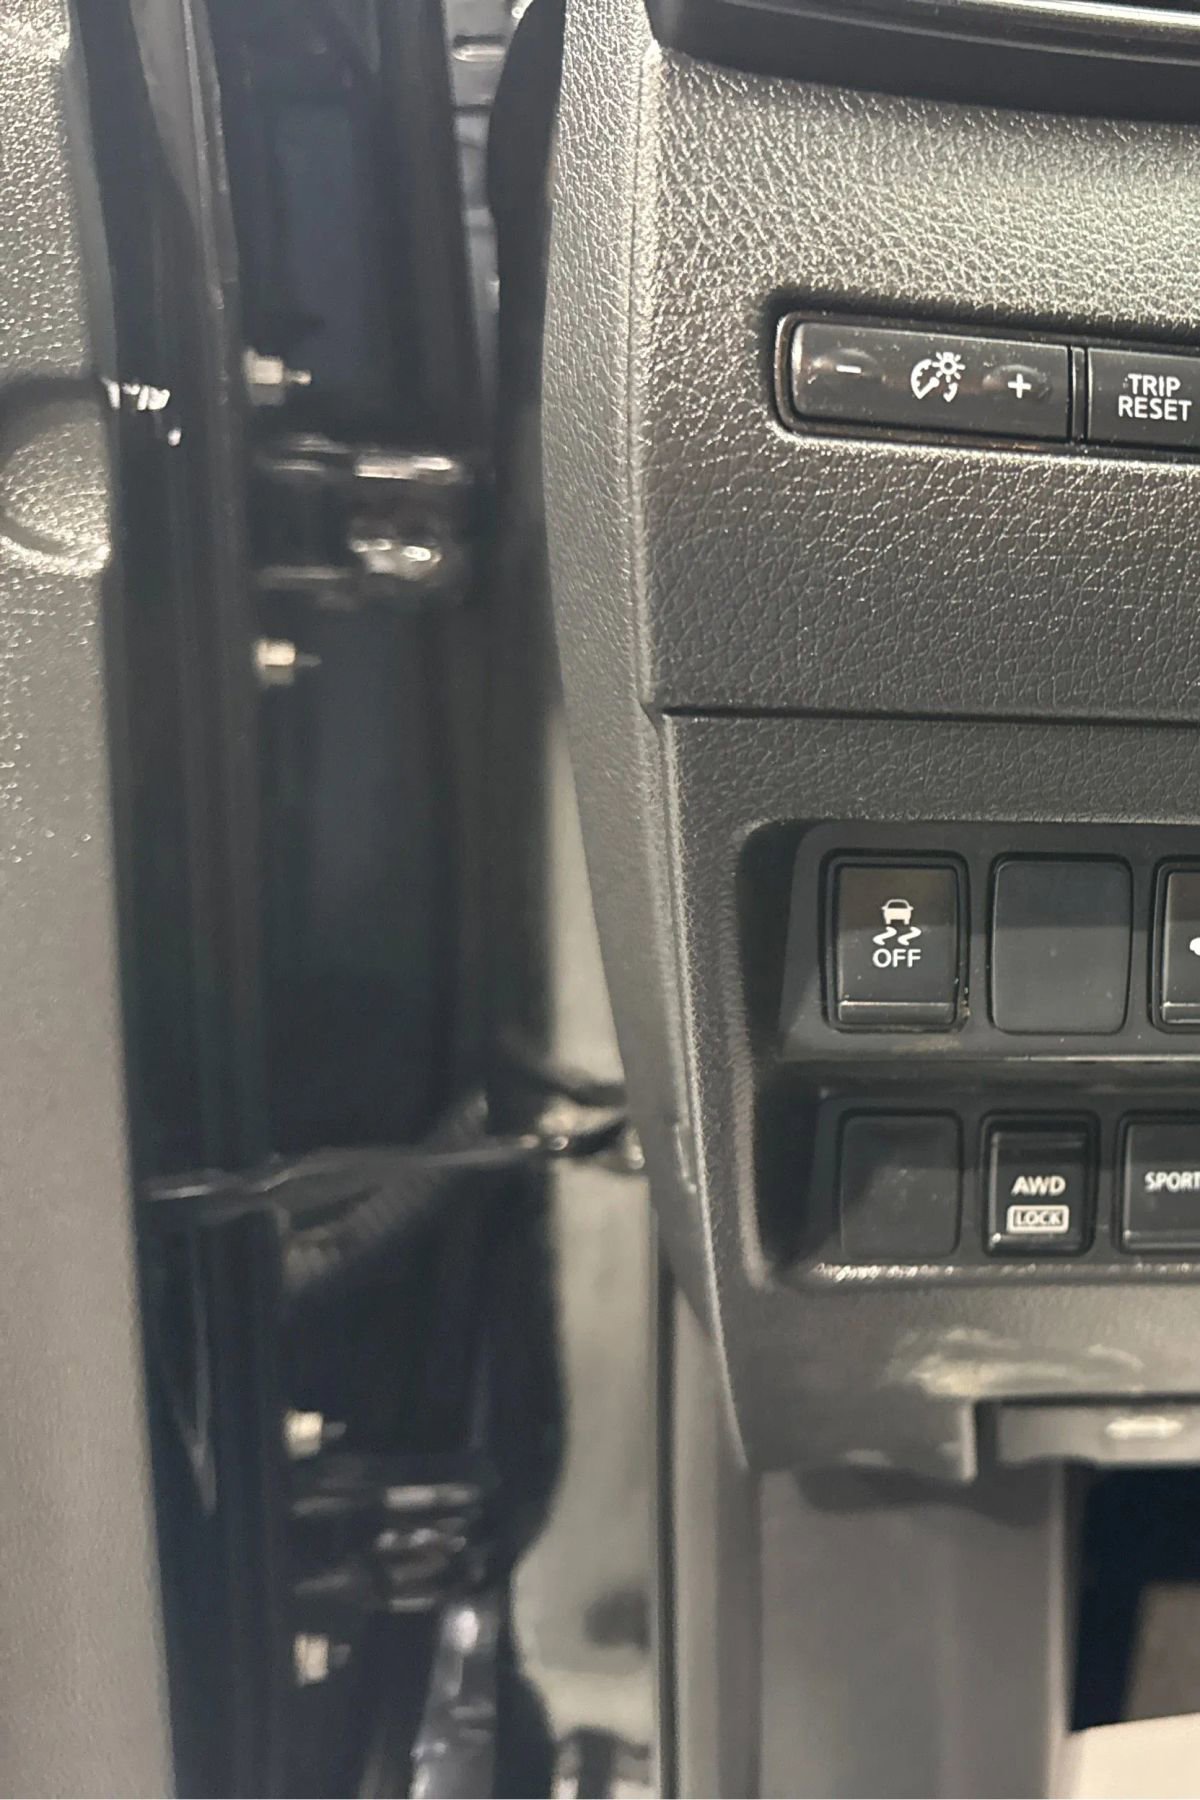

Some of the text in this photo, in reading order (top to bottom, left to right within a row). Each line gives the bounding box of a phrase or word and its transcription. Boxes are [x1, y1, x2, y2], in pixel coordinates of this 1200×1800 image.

[1127, 373, 1181, 398] TRIP
[1118, 395, 1192, 421] RESET
[872, 948, 922, 968] OFF
[1010, 1175, 1067, 1197] AWD
[1015, 1210, 1062, 1225] LOCK
